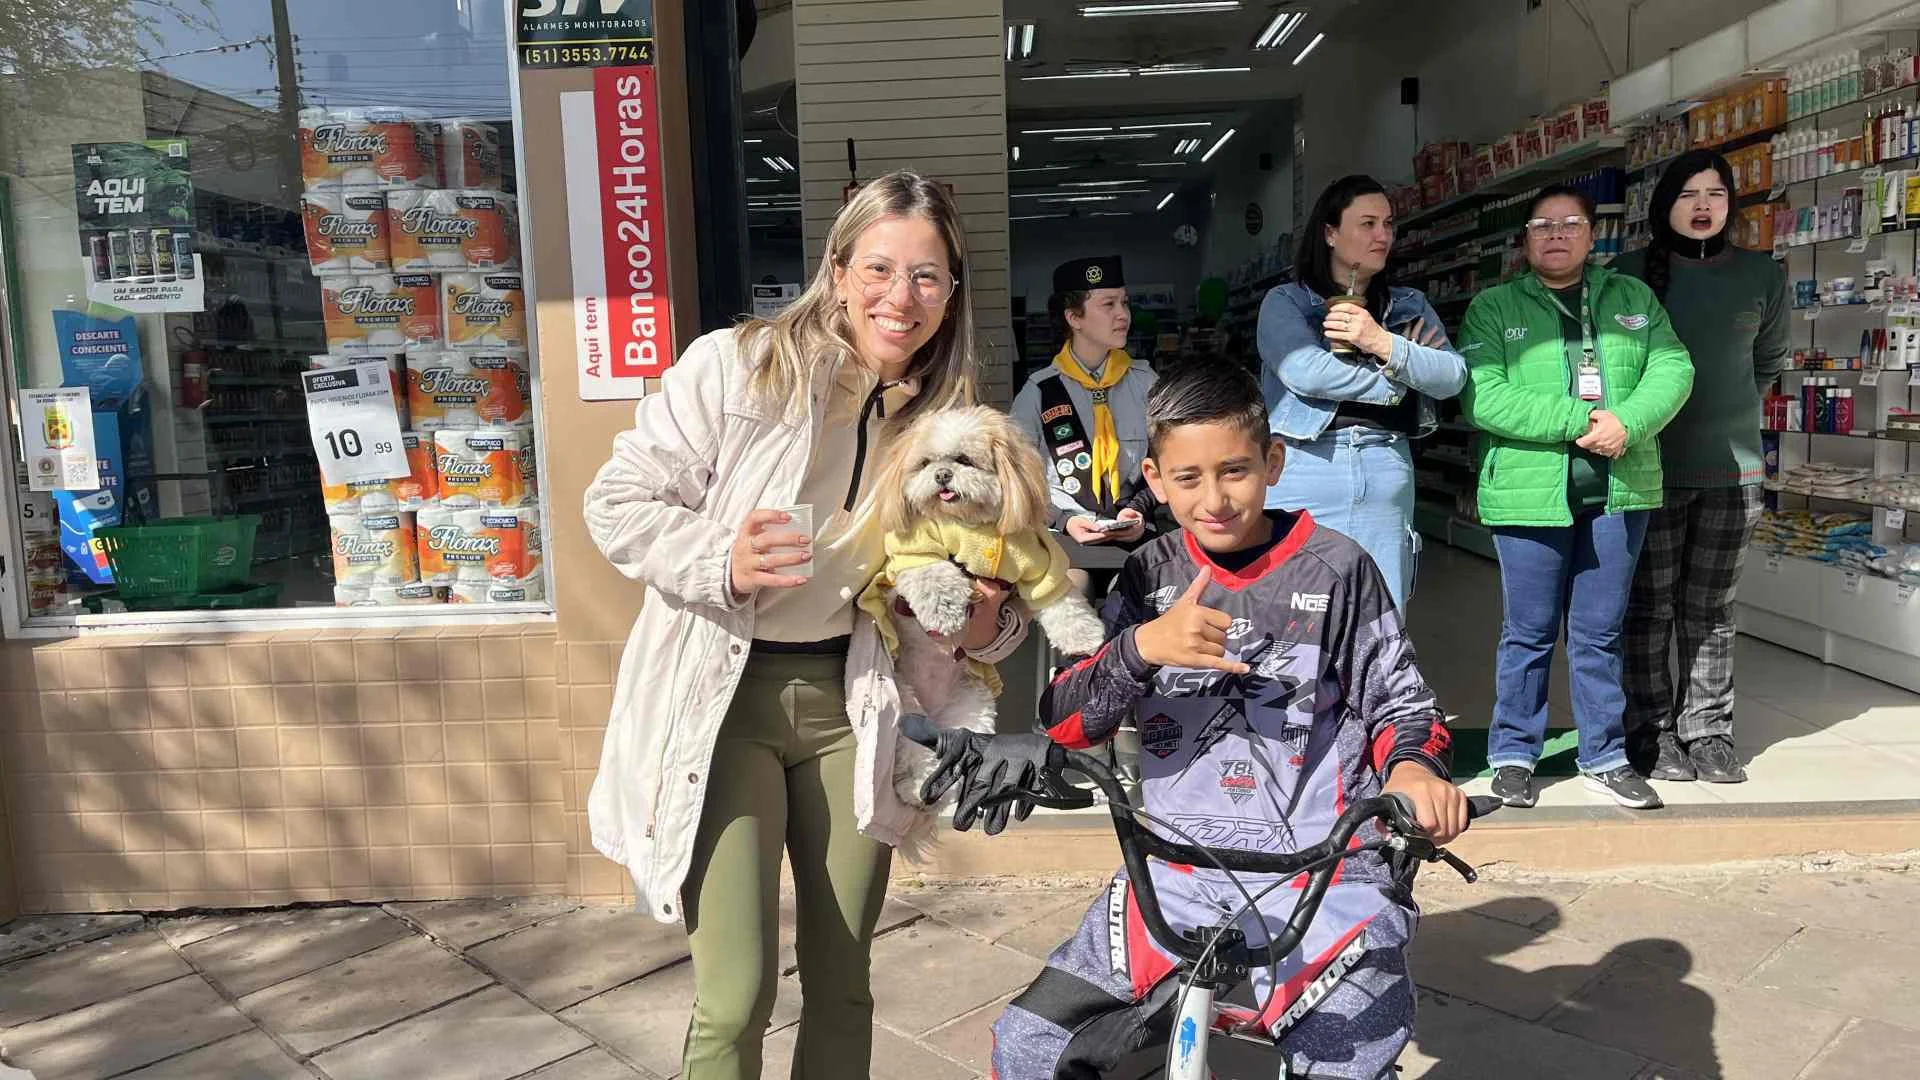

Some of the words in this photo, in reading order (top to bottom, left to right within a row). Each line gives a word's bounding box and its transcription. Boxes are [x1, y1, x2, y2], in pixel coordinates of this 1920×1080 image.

[523, 22, 570, 31] ALARMES
[574, 20, 647, 29] MONITORADOS
[313, 123, 387, 154] Florax
[86, 178, 145, 197] AQUI
[94, 197, 144, 214] TEM
[318, 214, 378, 239] Florax
[401, 206, 477, 238] Florax
[612, 74, 658, 368] Banco24Horas
[338, 287, 415, 315] Florax
[454, 293, 513, 318] Florax
[585, 297, 597, 331] tem
[76, 331, 120, 340] DESCARTE
[72, 344, 128, 354] CONSCIENTE
[585, 337, 603, 378] Aqui
[420, 367, 490, 397] Florax
[324, 428, 363, 460] 10
[438, 454, 492, 477] Florax
[24, 504, 34, 519] 5
[337, 534, 393, 557] Florax
[428, 525, 500, 554] Florax
